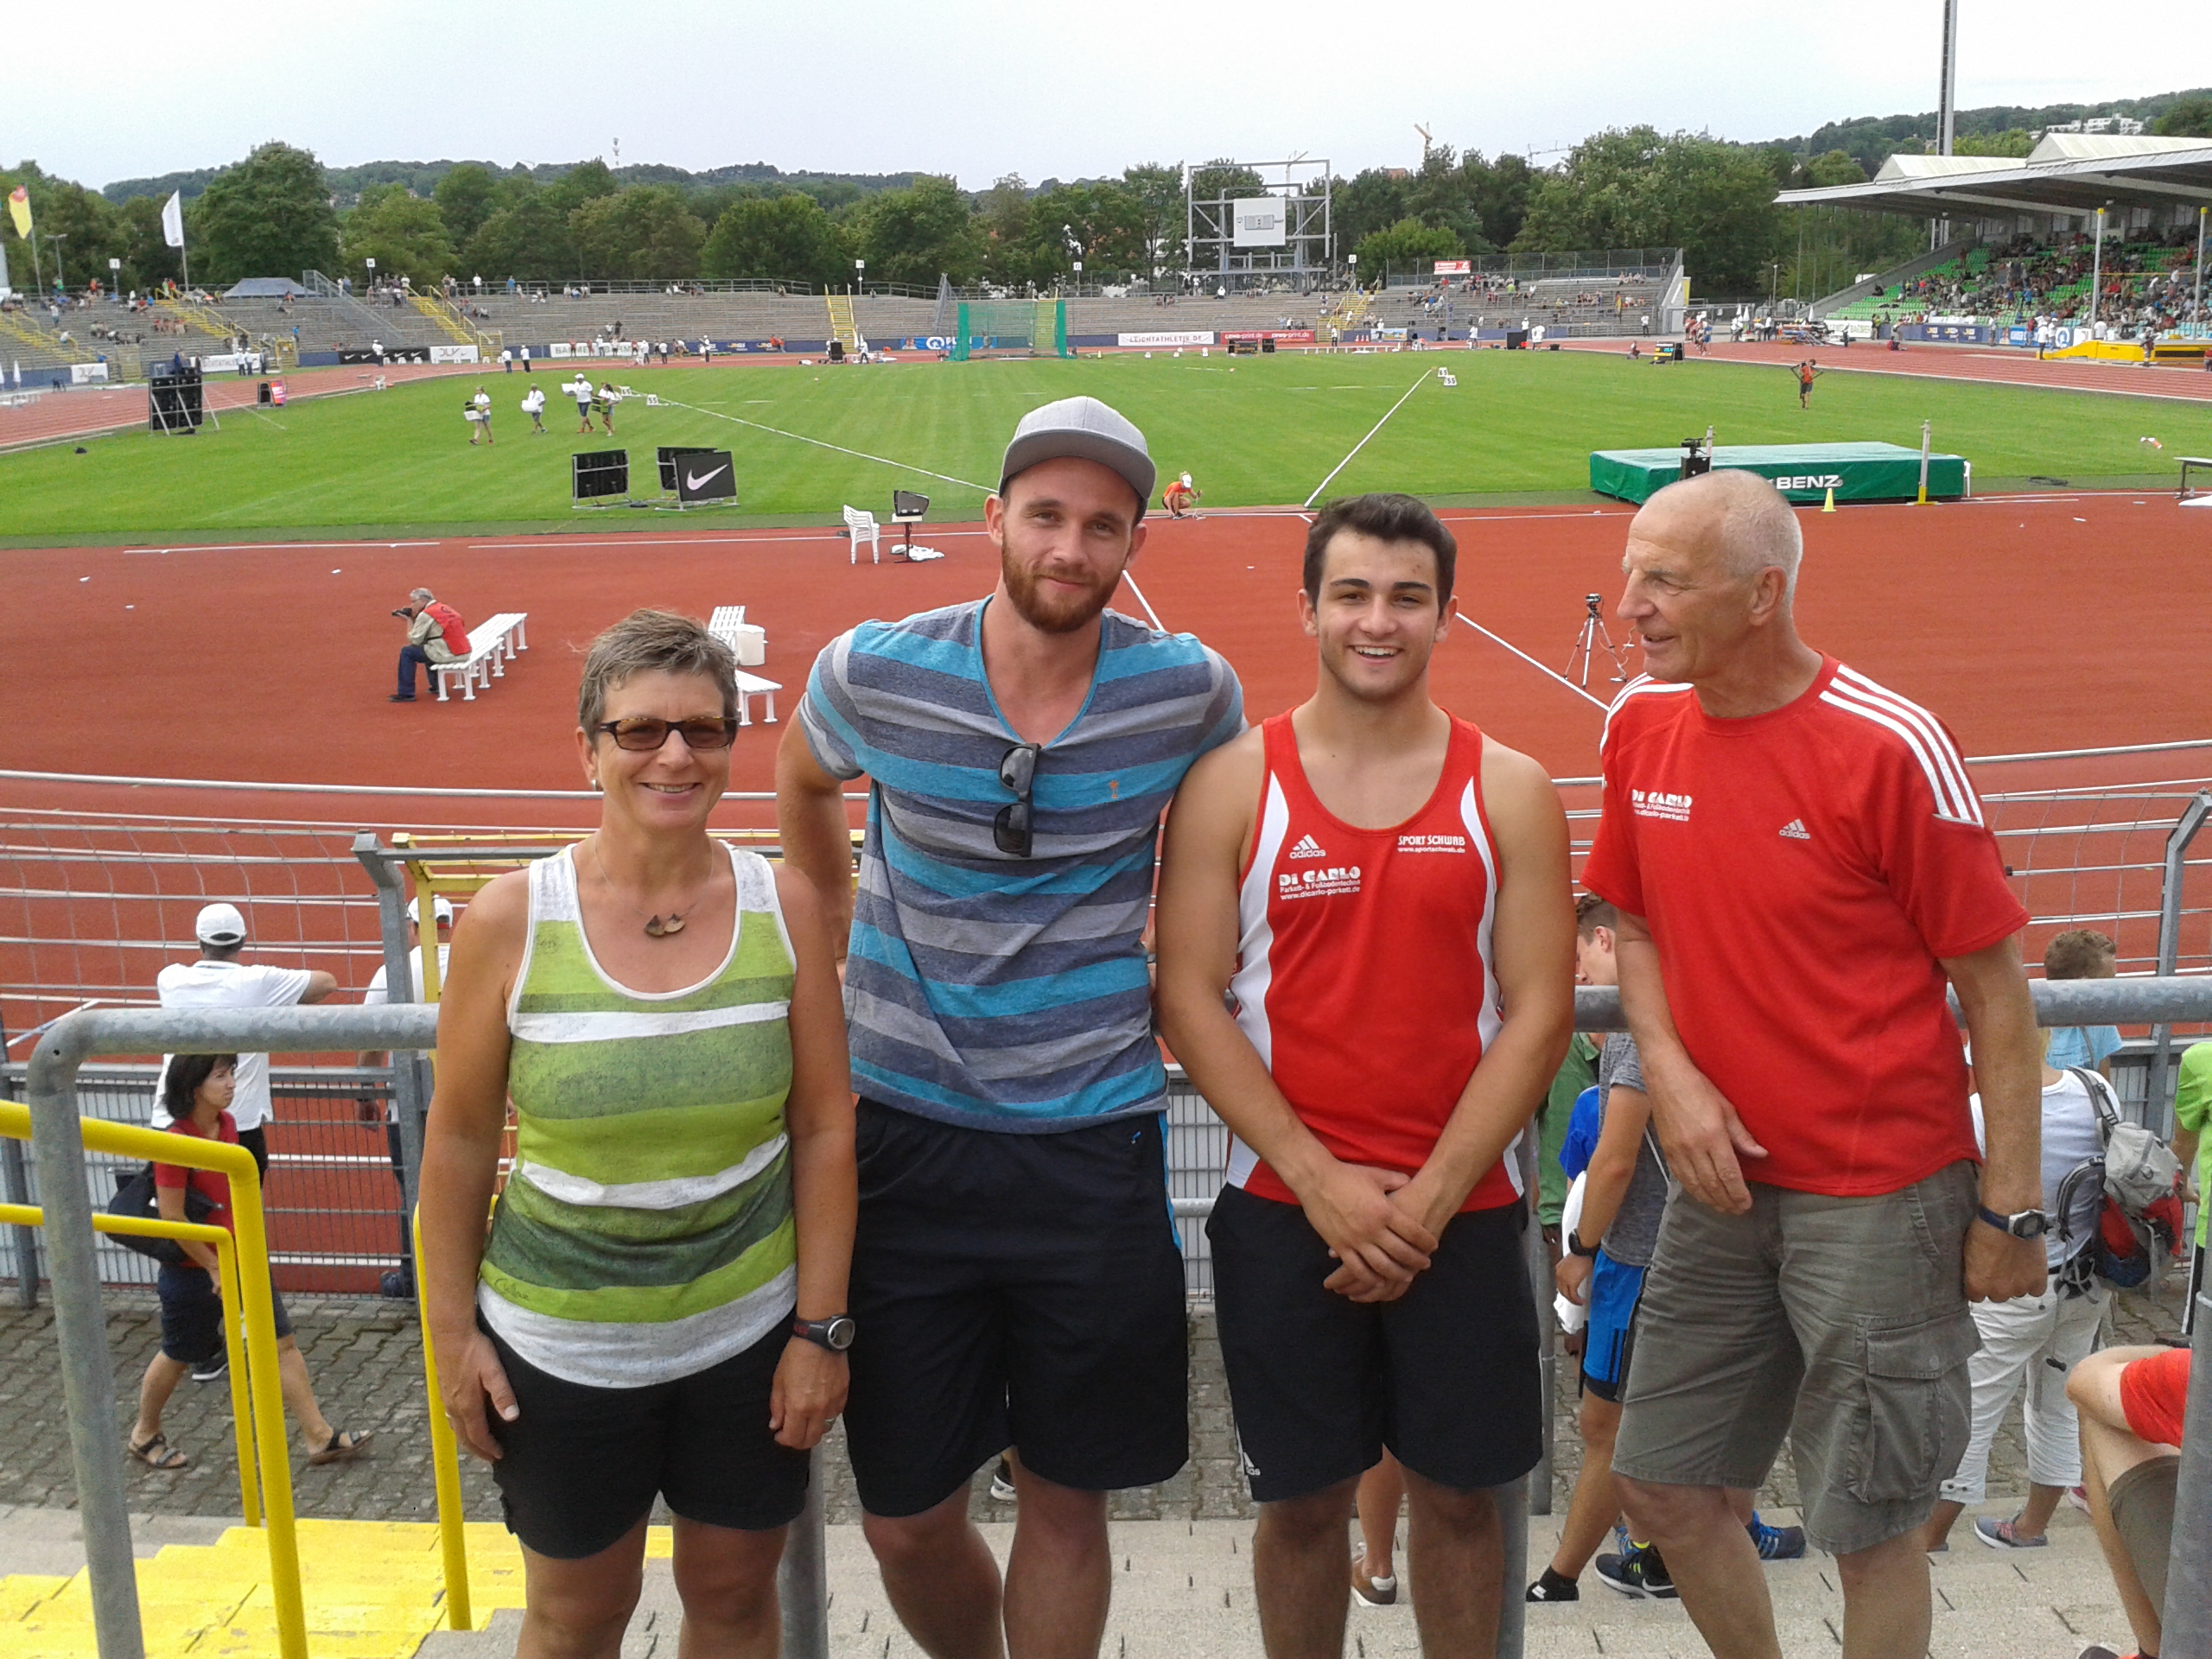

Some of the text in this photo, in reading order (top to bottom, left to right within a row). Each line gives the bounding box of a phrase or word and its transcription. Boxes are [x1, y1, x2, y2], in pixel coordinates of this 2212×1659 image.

[1777, 474, 1840, 490] BENZ
[1779, 830, 1811, 839] adidas
[1397, 835, 1465, 846] SPORT SCHWAB
[1289, 849, 1326, 860] adidas
[1302, 866, 1361, 882] CARLO
